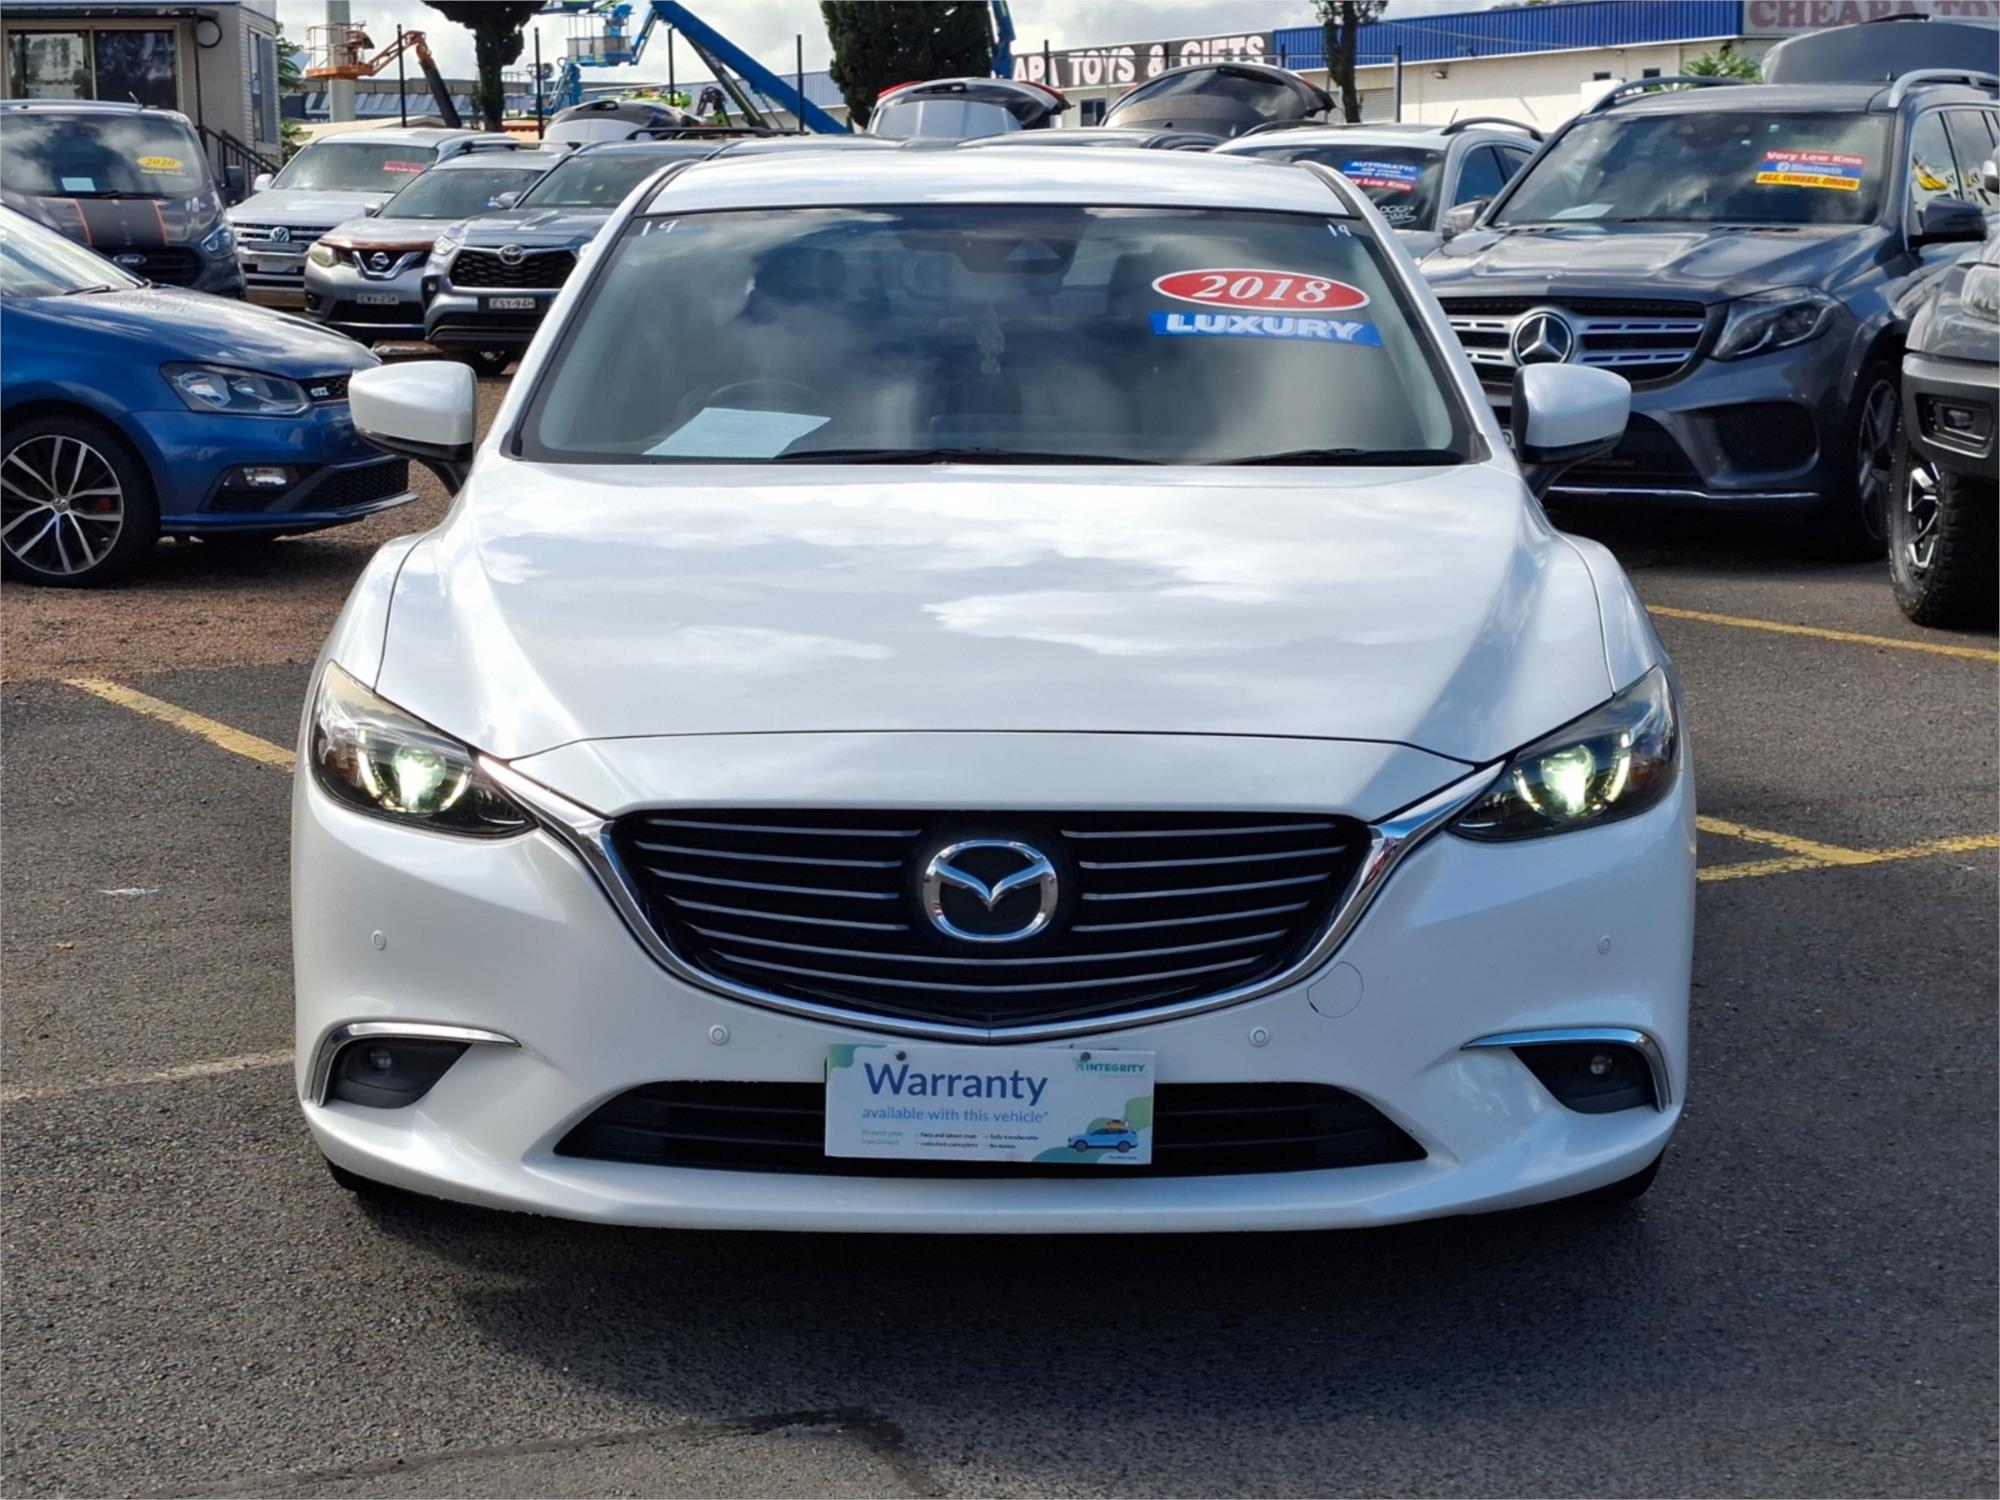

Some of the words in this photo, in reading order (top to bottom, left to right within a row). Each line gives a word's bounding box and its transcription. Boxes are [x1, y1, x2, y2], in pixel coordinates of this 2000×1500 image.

[1749, 0, 1917, 27] CHEAPA
[1933, 0, 1999, 17] TO
[1068, 46, 1135, 86] TOYS
[1147, 43, 1165, 77] &
[1180, 35, 1265, 67] GIFTS
[145, 157, 177, 167] 2020
[1766, 150, 1798, 162] Very
[1800, 153, 1830, 162] Low
[1832, 154, 1864, 165] Kms
[1351, 161, 1416, 172] AUTOMATIC
[1790, 163, 1842, 175] Bluetooth
[1759, 173, 1779, 182] ALL
[1782, 174, 1820, 184] WHEEL
[1822, 176, 1859, 188] DRIVE
[641, 220, 680, 236] 19
[1327, 224, 1352, 237] 19
[1191, 275, 1332, 303] 2018
[1166, 313, 1365, 341] LUXURY
[1085, 1063, 1146, 1073] INTEGRITY
[863, 1062, 1048, 1106] Warranty
[862, 1106, 924, 1120] available
[926, 1107, 959, 1121] with
[964, 1108, 989, 1122] this
